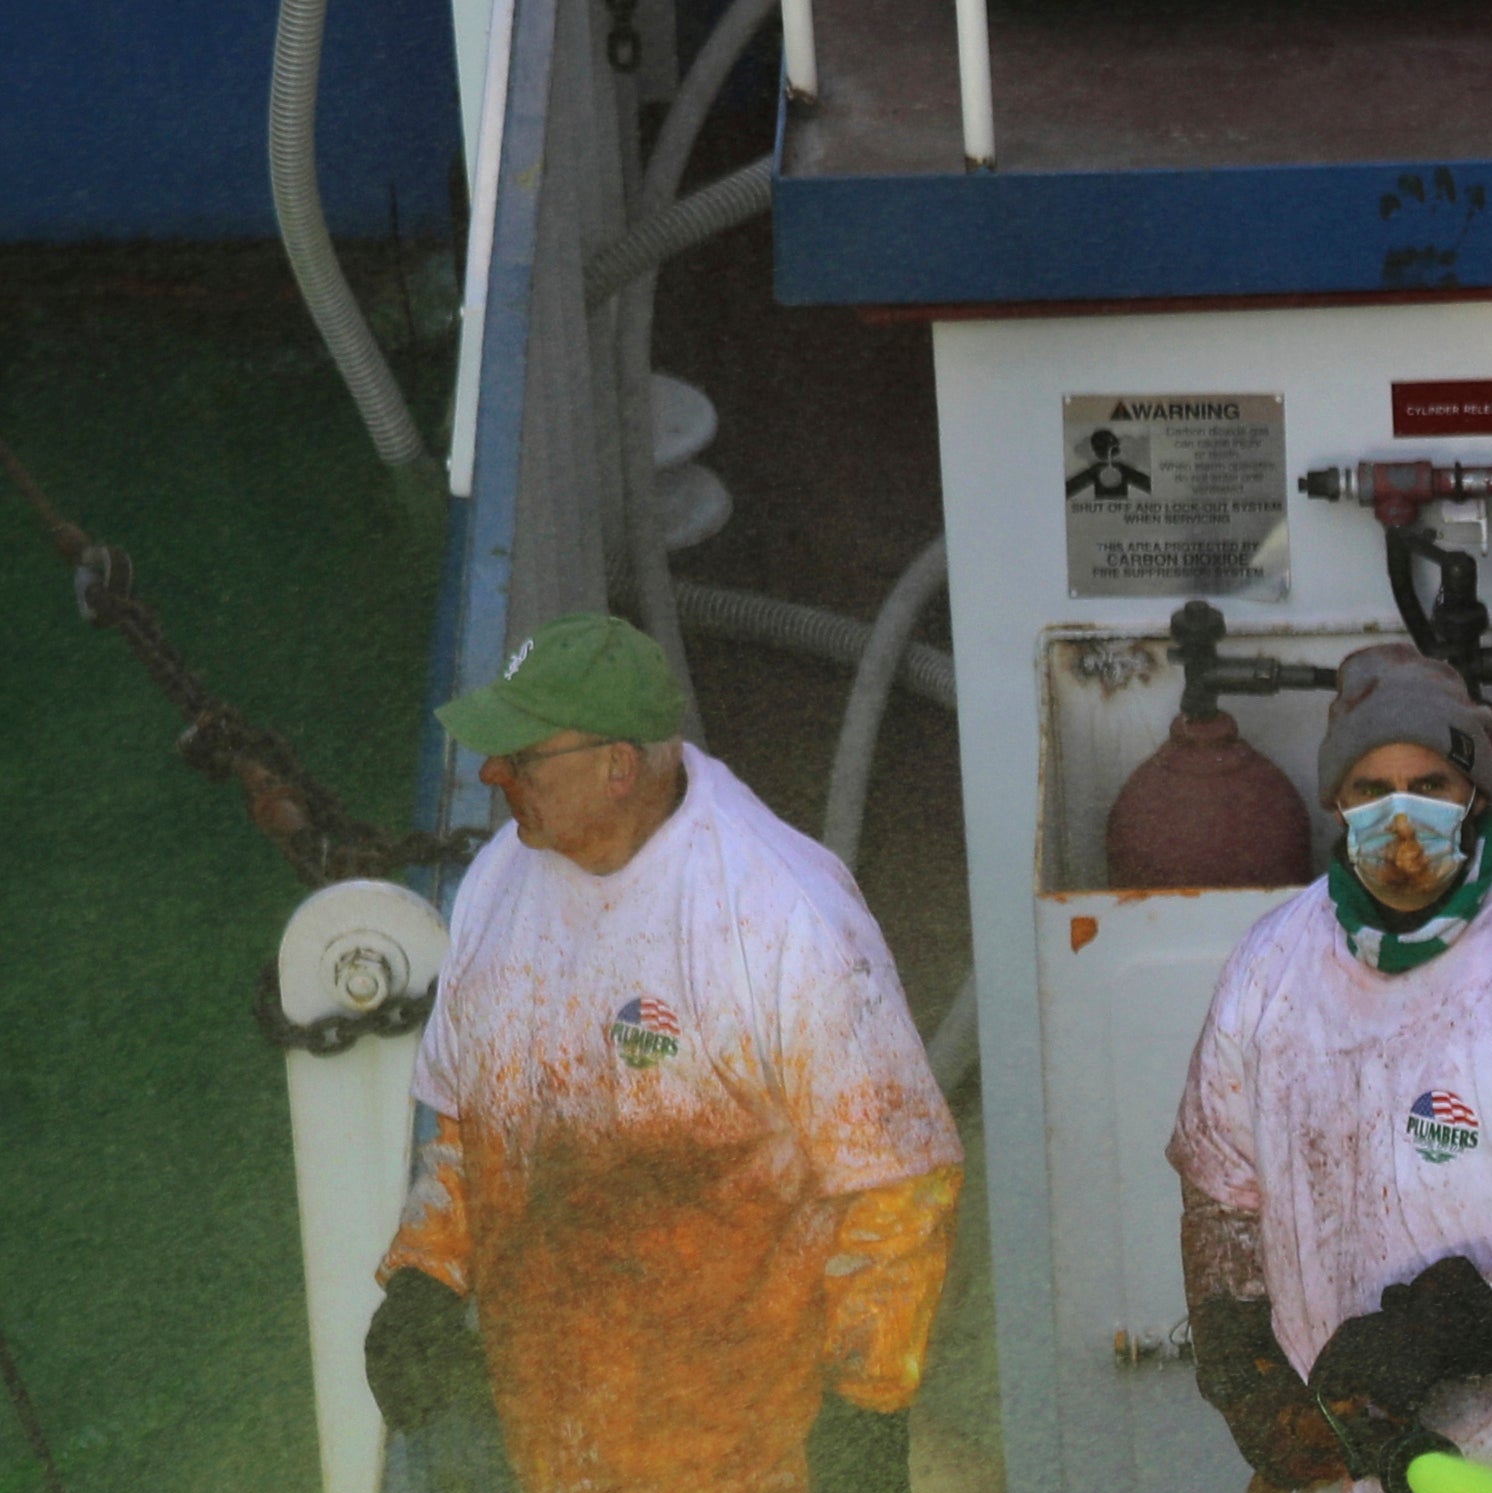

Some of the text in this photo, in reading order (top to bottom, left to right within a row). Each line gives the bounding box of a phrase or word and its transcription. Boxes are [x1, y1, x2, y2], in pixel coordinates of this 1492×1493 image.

[1132, 402, 1240, 420] WARNING
[1406, 405, 1460, 416] CYLINDER
[1071, 501, 1283, 513] SHUT OFF AND LOCK OUT SYSTEM
[1124, 514, 1231, 524] WHEN SERVICING
[1097, 542, 1124, 553] THIS
[1128, 542, 1160, 552] AREA
[1164, 541, 1239, 552] PROTECTED
[1106, 553, 1250, 567] CARBON DIOXIDE
[1092, 567, 1264, 578] FIRE SUPPRESSION SYSTEM
[1406, 1115, 1479, 1149] PLUMBERS
